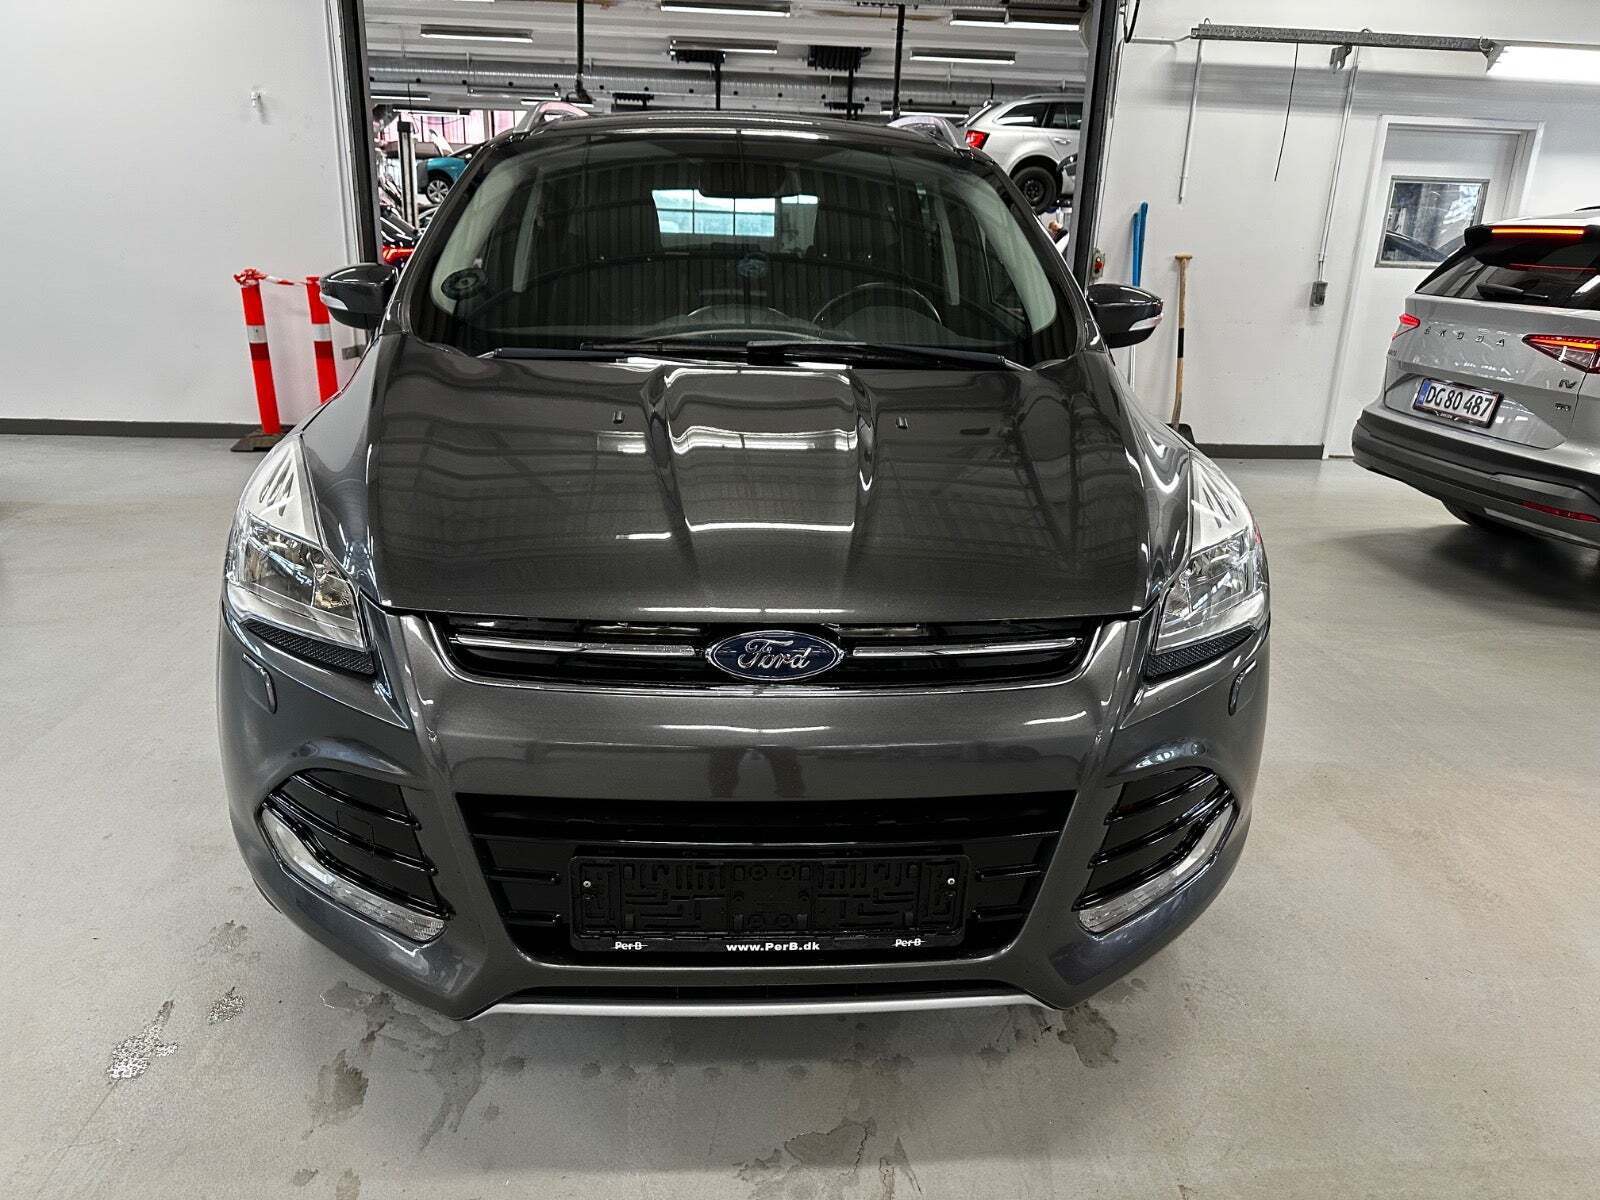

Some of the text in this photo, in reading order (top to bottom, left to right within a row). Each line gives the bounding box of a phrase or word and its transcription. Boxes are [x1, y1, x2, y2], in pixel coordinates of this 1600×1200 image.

[1424, 385, 1445, 407] DG
[1443, 389, 1464, 411] 80
[1462, 394, 1494, 417] 487
[737, 638, 812, 669] Ford
[725, 941, 820, 952] www.PerB.dk
